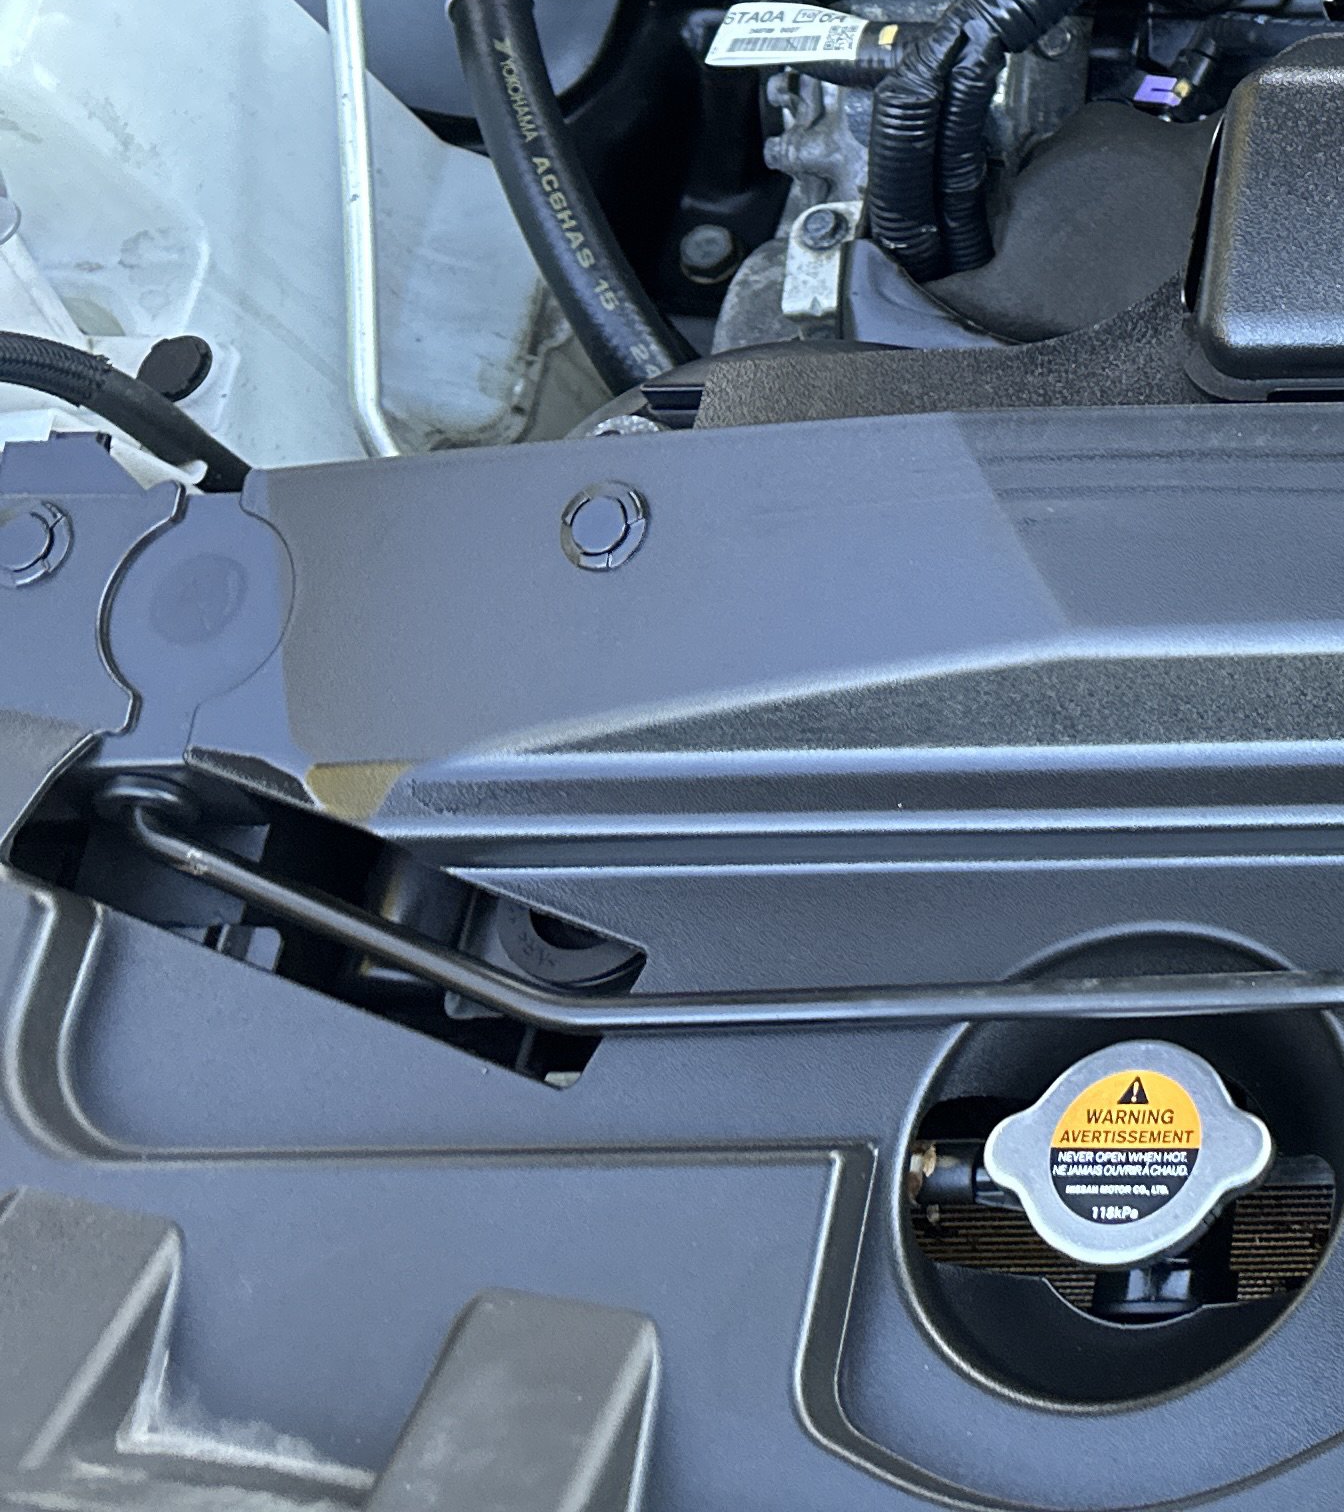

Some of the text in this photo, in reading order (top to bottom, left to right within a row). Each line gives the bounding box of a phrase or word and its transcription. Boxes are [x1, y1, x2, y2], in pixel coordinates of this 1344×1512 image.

[500, 56, 539, 144] YOKOHAMA
[593, 278, 620, 312] 15
[1086, 1108, 1175, 1125] WARNING
[1059, 1129, 1194, 1144] AVERTISSEMENT
[1057, 1151, 1094, 1163] NEVER
[1095, 1151, 1127, 1163] OPEN
[1128, 1151, 1163, 1163] WHEN
[1103, 1164, 1141, 1177] OUVRIR
[1100, 1184, 1132, 1194] MOTOR
